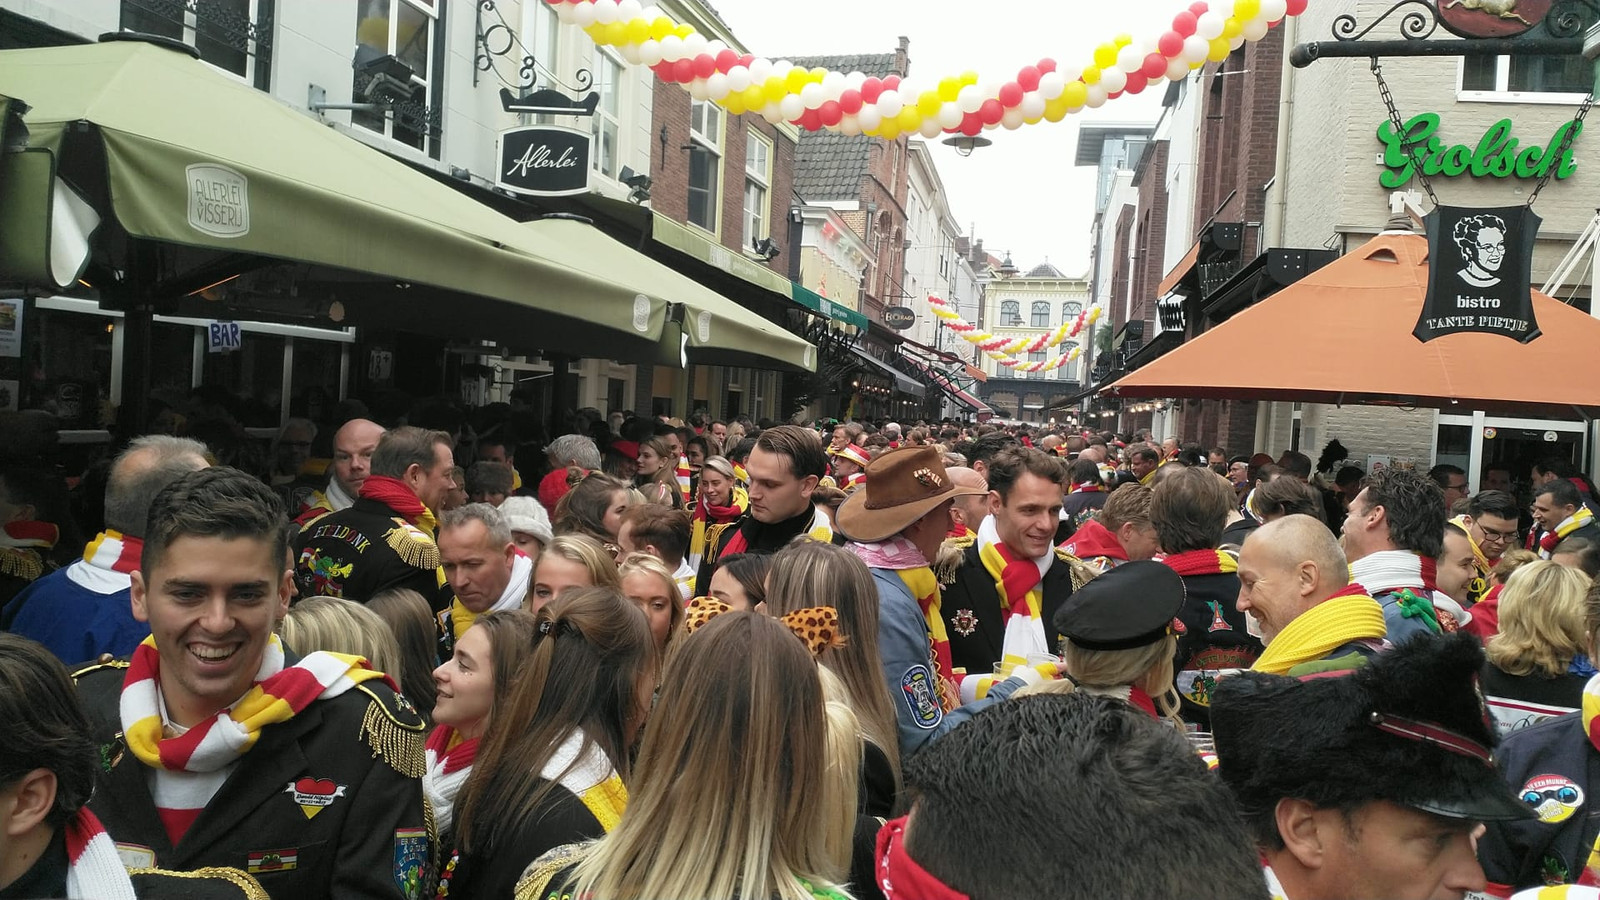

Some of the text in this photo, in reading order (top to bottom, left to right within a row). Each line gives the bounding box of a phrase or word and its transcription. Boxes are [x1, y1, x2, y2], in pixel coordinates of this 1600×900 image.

[506, 142, 578, 178] Allerlei
[1376, 112, 1584, 188] Grolsch
[195, 178, 242, 206] ALLERLEI
[1456, 295, 1501, 309] bistro
[210, 322, 241, 347] BAR
[1426, 316, 1529, 332] TANTE PIETJE
